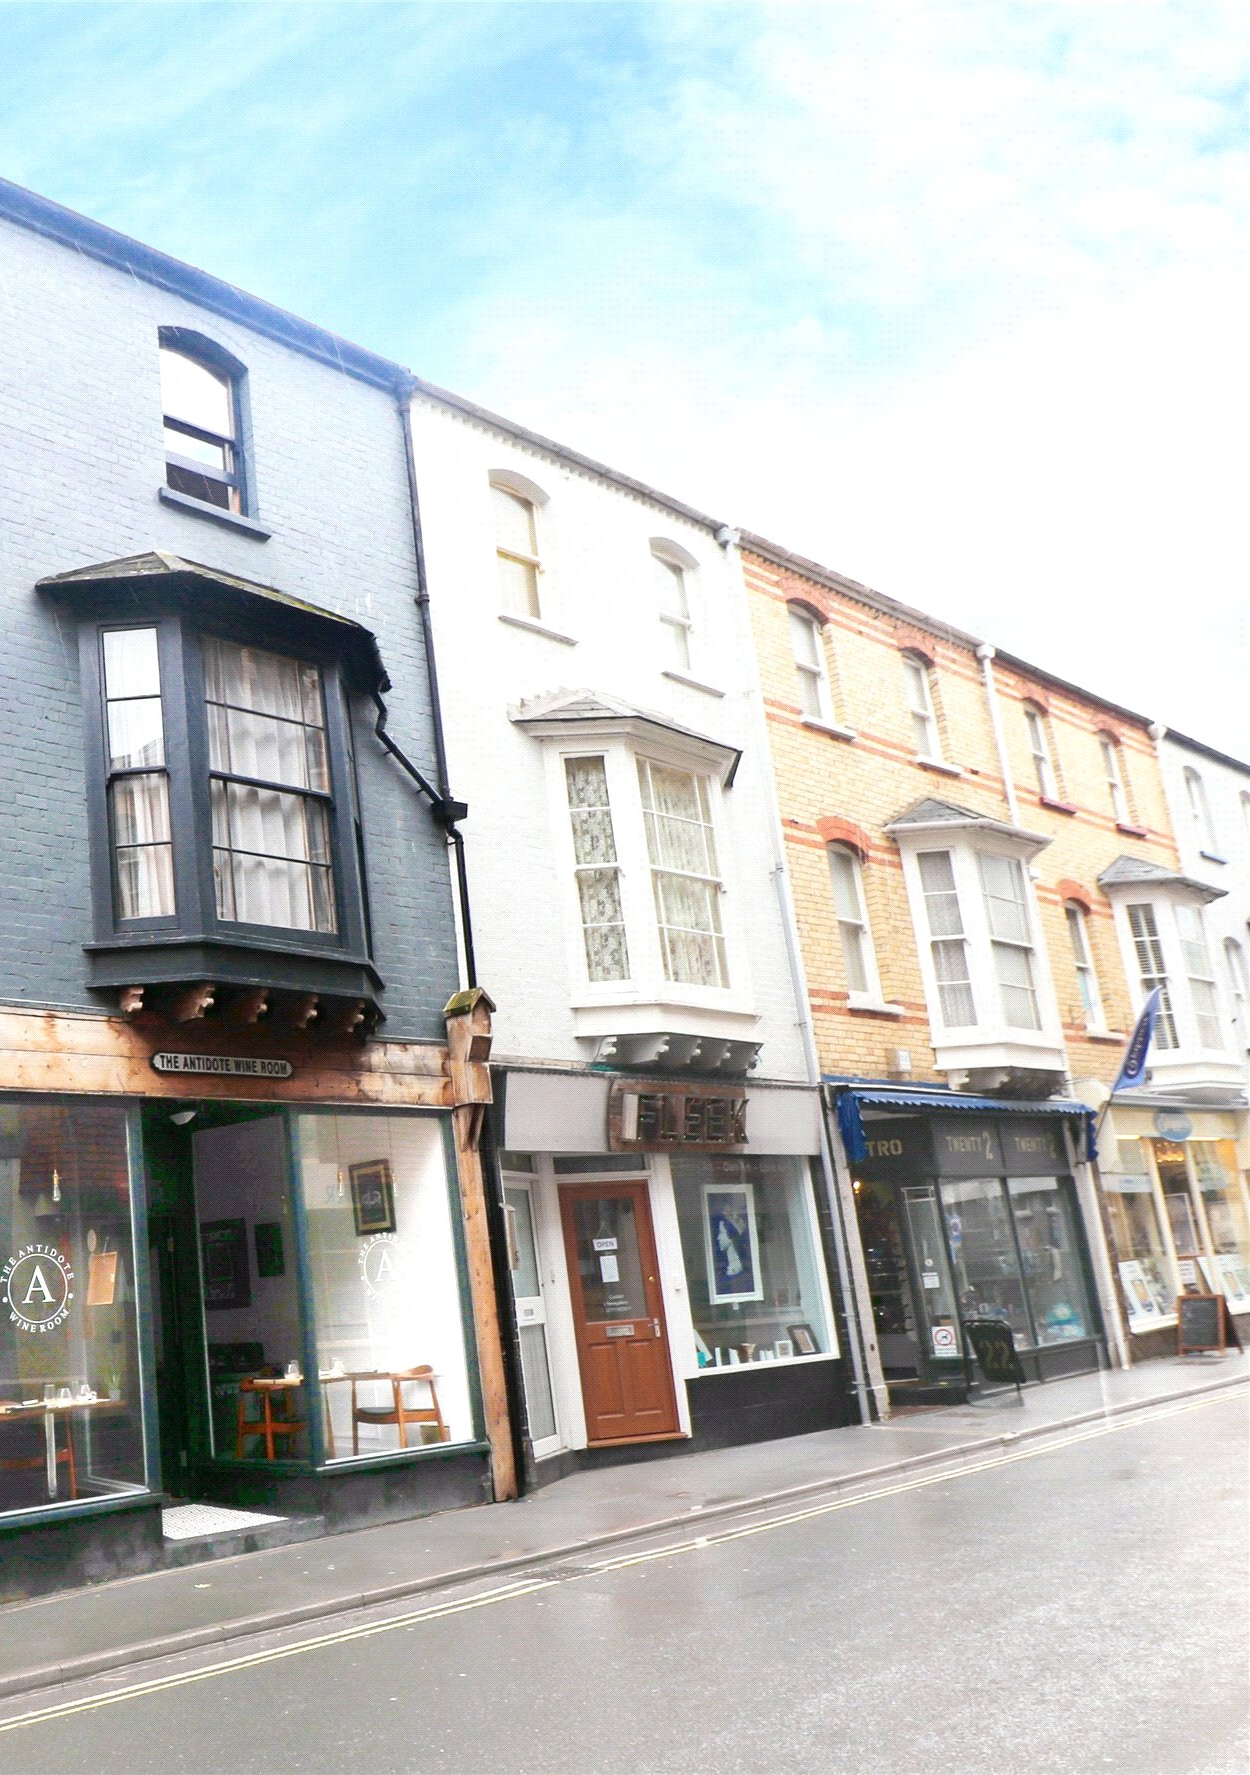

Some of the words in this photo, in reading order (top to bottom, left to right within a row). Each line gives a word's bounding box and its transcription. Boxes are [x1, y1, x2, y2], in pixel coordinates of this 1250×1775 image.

[159, 1054, 180, 1069] THE
[182, 1055, 231, 1072] ANTIDOTE
[233, 1059, 258, 1073] WINE
[261, 1060, 287, 1075] ROOM
[865, 1138, 903, 1157] TRO
[596, 1240, 615, 1249] OPEN
[0, 1257, 17, 1284] THE
[18, 1244, 75, 1280] ANTIDOTE
[21, 1264, 57, 1304] A
[9, 1311, 37, 1333] WINE
[39, 1308, 70, 1333] ROOM
